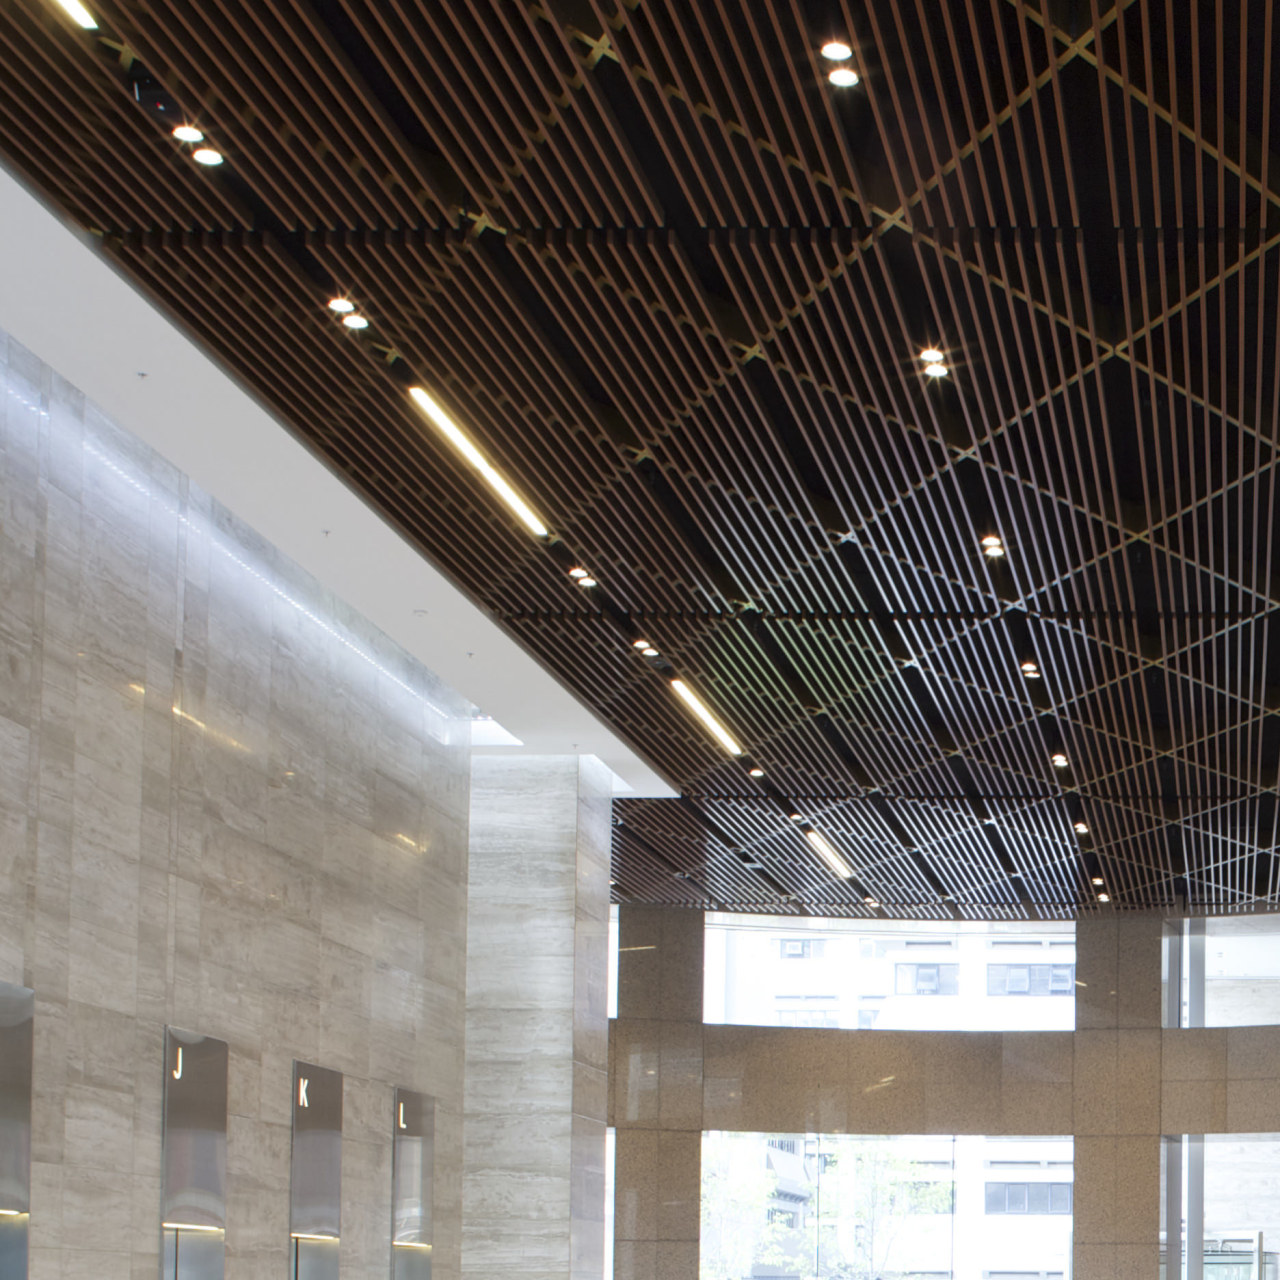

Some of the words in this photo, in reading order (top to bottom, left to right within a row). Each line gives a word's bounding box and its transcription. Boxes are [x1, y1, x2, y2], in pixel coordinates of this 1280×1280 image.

[172, 1047, 183, 1080] J
[299, 1077, 309, 1108] K
[398, 1102, 407, 1129] L
